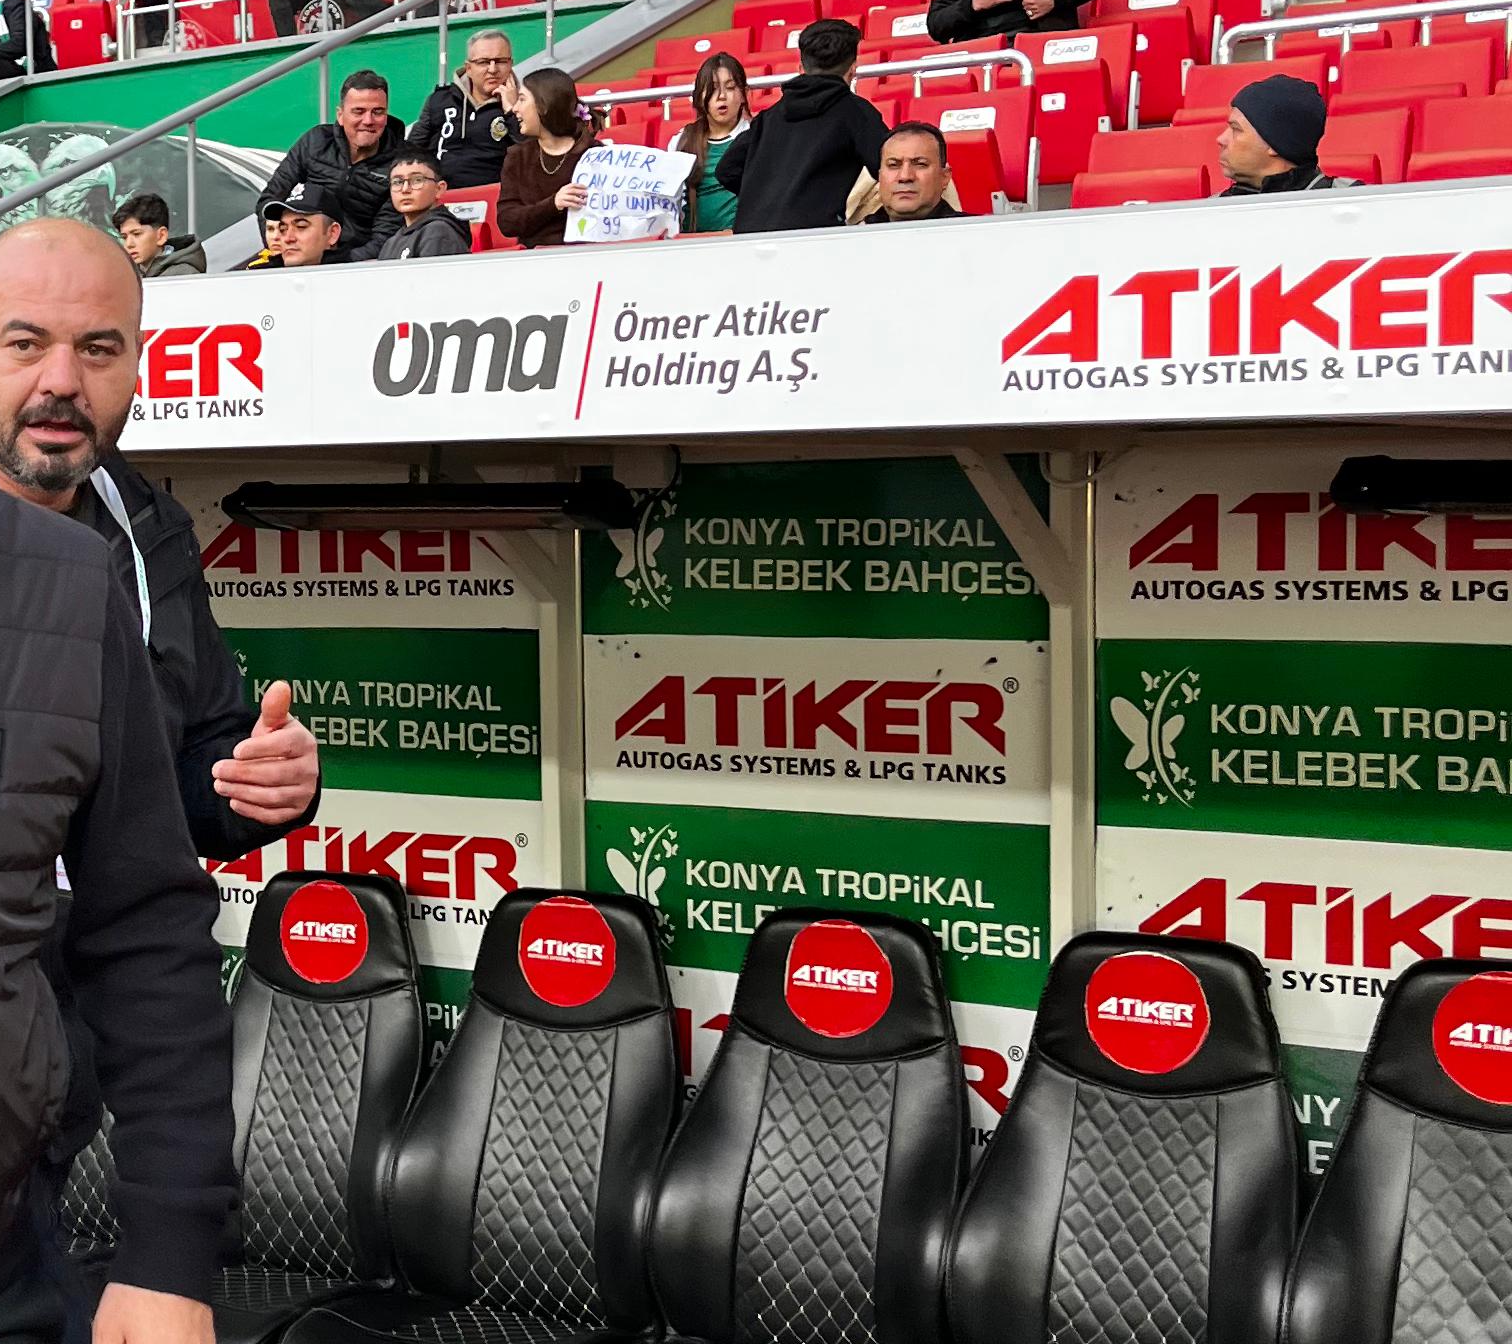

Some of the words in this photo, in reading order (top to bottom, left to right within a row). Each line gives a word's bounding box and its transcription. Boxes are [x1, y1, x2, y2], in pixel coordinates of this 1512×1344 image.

[614, 301, 707, 344] Ömer
[715, 297, 829, 338] Atiker
[605, 348, 734, 394] Holding
[746, 343, 819, 393] A.Ş.
[1002, 365, 1150, 392] AUTOGAS
[1160, 359, 1307, 386] SYSTEMS
[1322, 357, 1344, 379] &
[1356, 354, 1420, 378] LPG
[152, 401, 189, 420] LPG
[196, 399, 264, 419] TANKS
[684, 517, 804, 547] KONYA
[293, 579, 379, 597] SYSTEMS
[385, 579, 399, 597] &
[404, 579, 441, 597] LPG
[447, 578, 515, 597] TANKS
[684, 558, 852, 592] KELEBEK
[1131, 579, 1264, 600] AUTOGAS
[1274, 579, 1409, 602] SYSTEMS
[1419, 580, 1441, 602] &
[1451, 580, 1509, 602] LPG
[254, 678, 351, 706] KNYA
[310, 716, 389, 748] EBEK
[1211, 703, 1360, 736] KONYA
[617, 749, 723, 772] AUTOGAS
[729, 752, 836, 778] SYSTEMS
[844, 759, 861, 778] &
[869, 760, 914, 783] LPG
[922, 762, 1007, 786] TANKS
[1211, 748, 1421, 789] KELEBEK
[1437, 753, 1512, 794] BA
[685, 858, 806, 896] KONYA
[410, 903, 446, 921] LPG
[453, 907, 494, 925] TAN
[1281, 968, 1393, 998] SYSTEM
